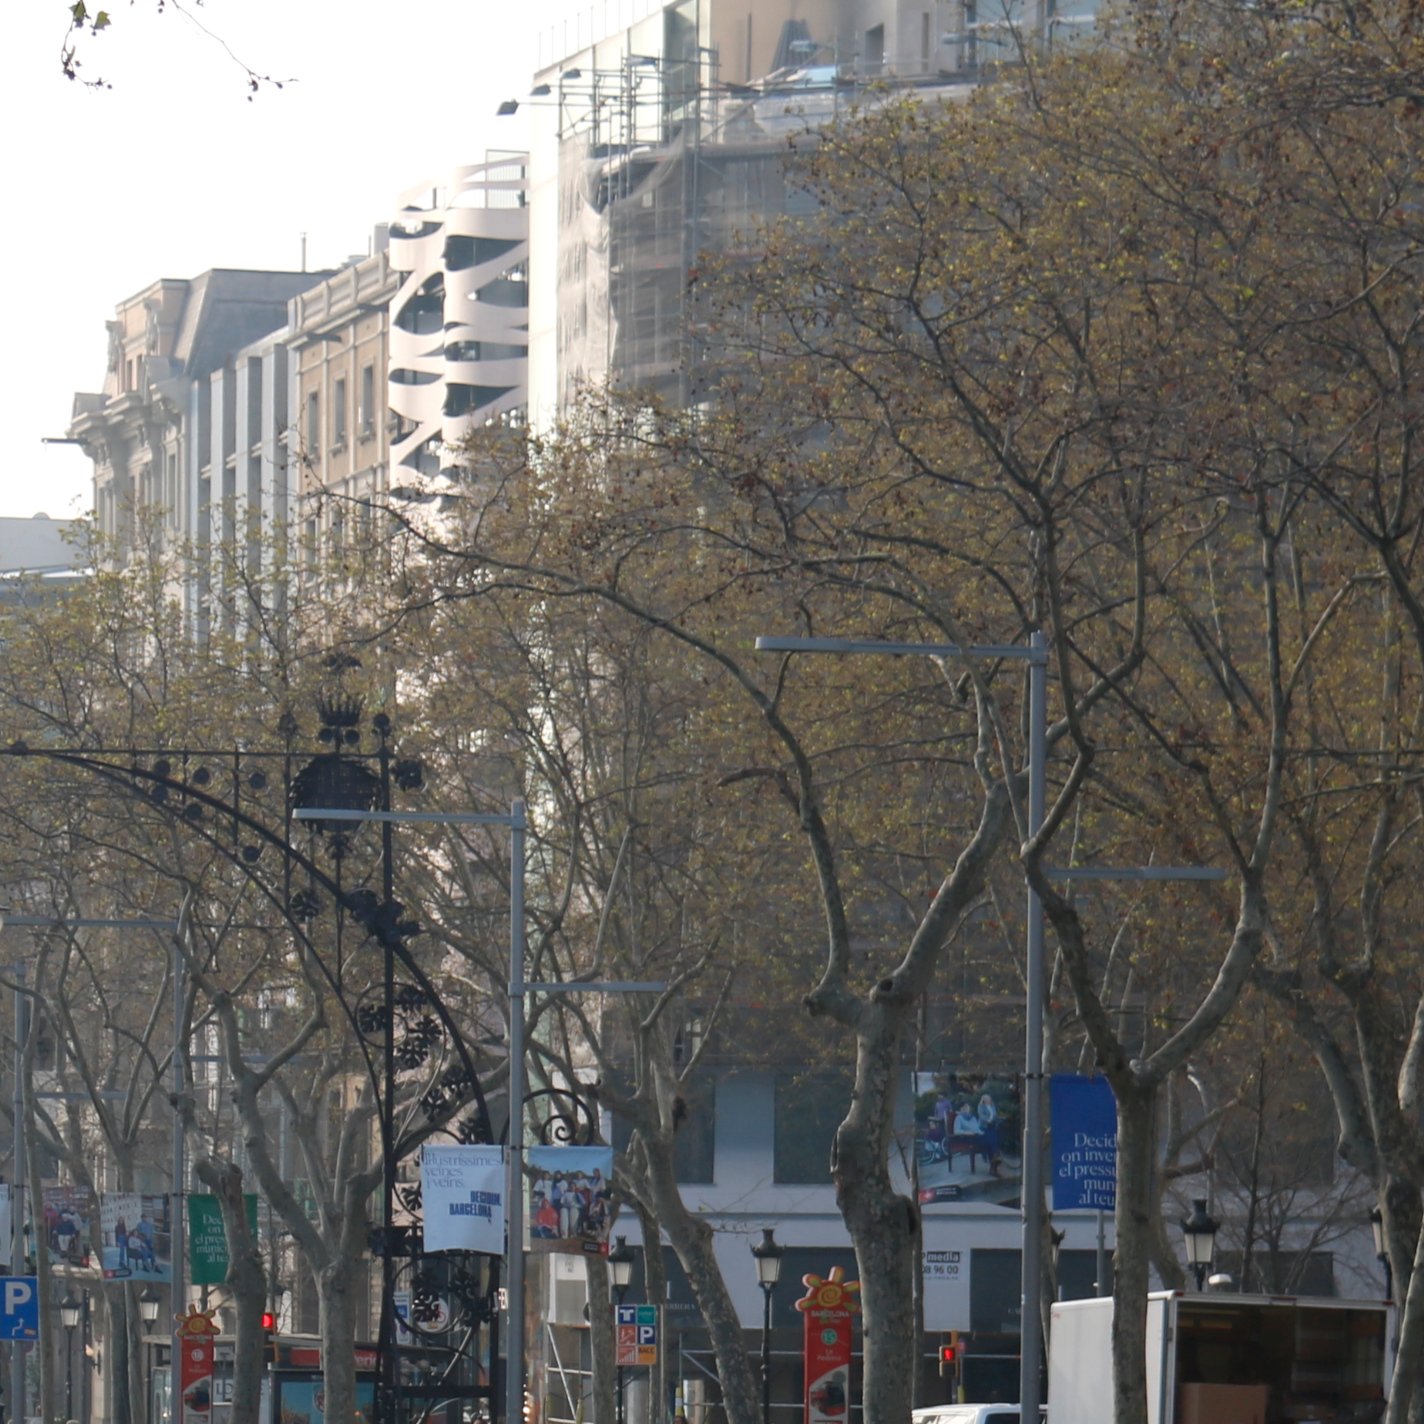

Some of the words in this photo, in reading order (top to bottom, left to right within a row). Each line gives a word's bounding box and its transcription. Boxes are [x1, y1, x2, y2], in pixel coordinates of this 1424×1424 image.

[1061, 1151, 1081, 1163] on
[1059, 1162, 1071, 1177] el
[1078, 1190, 1091, 1204] al
[449, 1203, 493, 1219] BARCELONA
[5, 1281, 32, 1315] P
[639, 1326, 654, 1344] P
